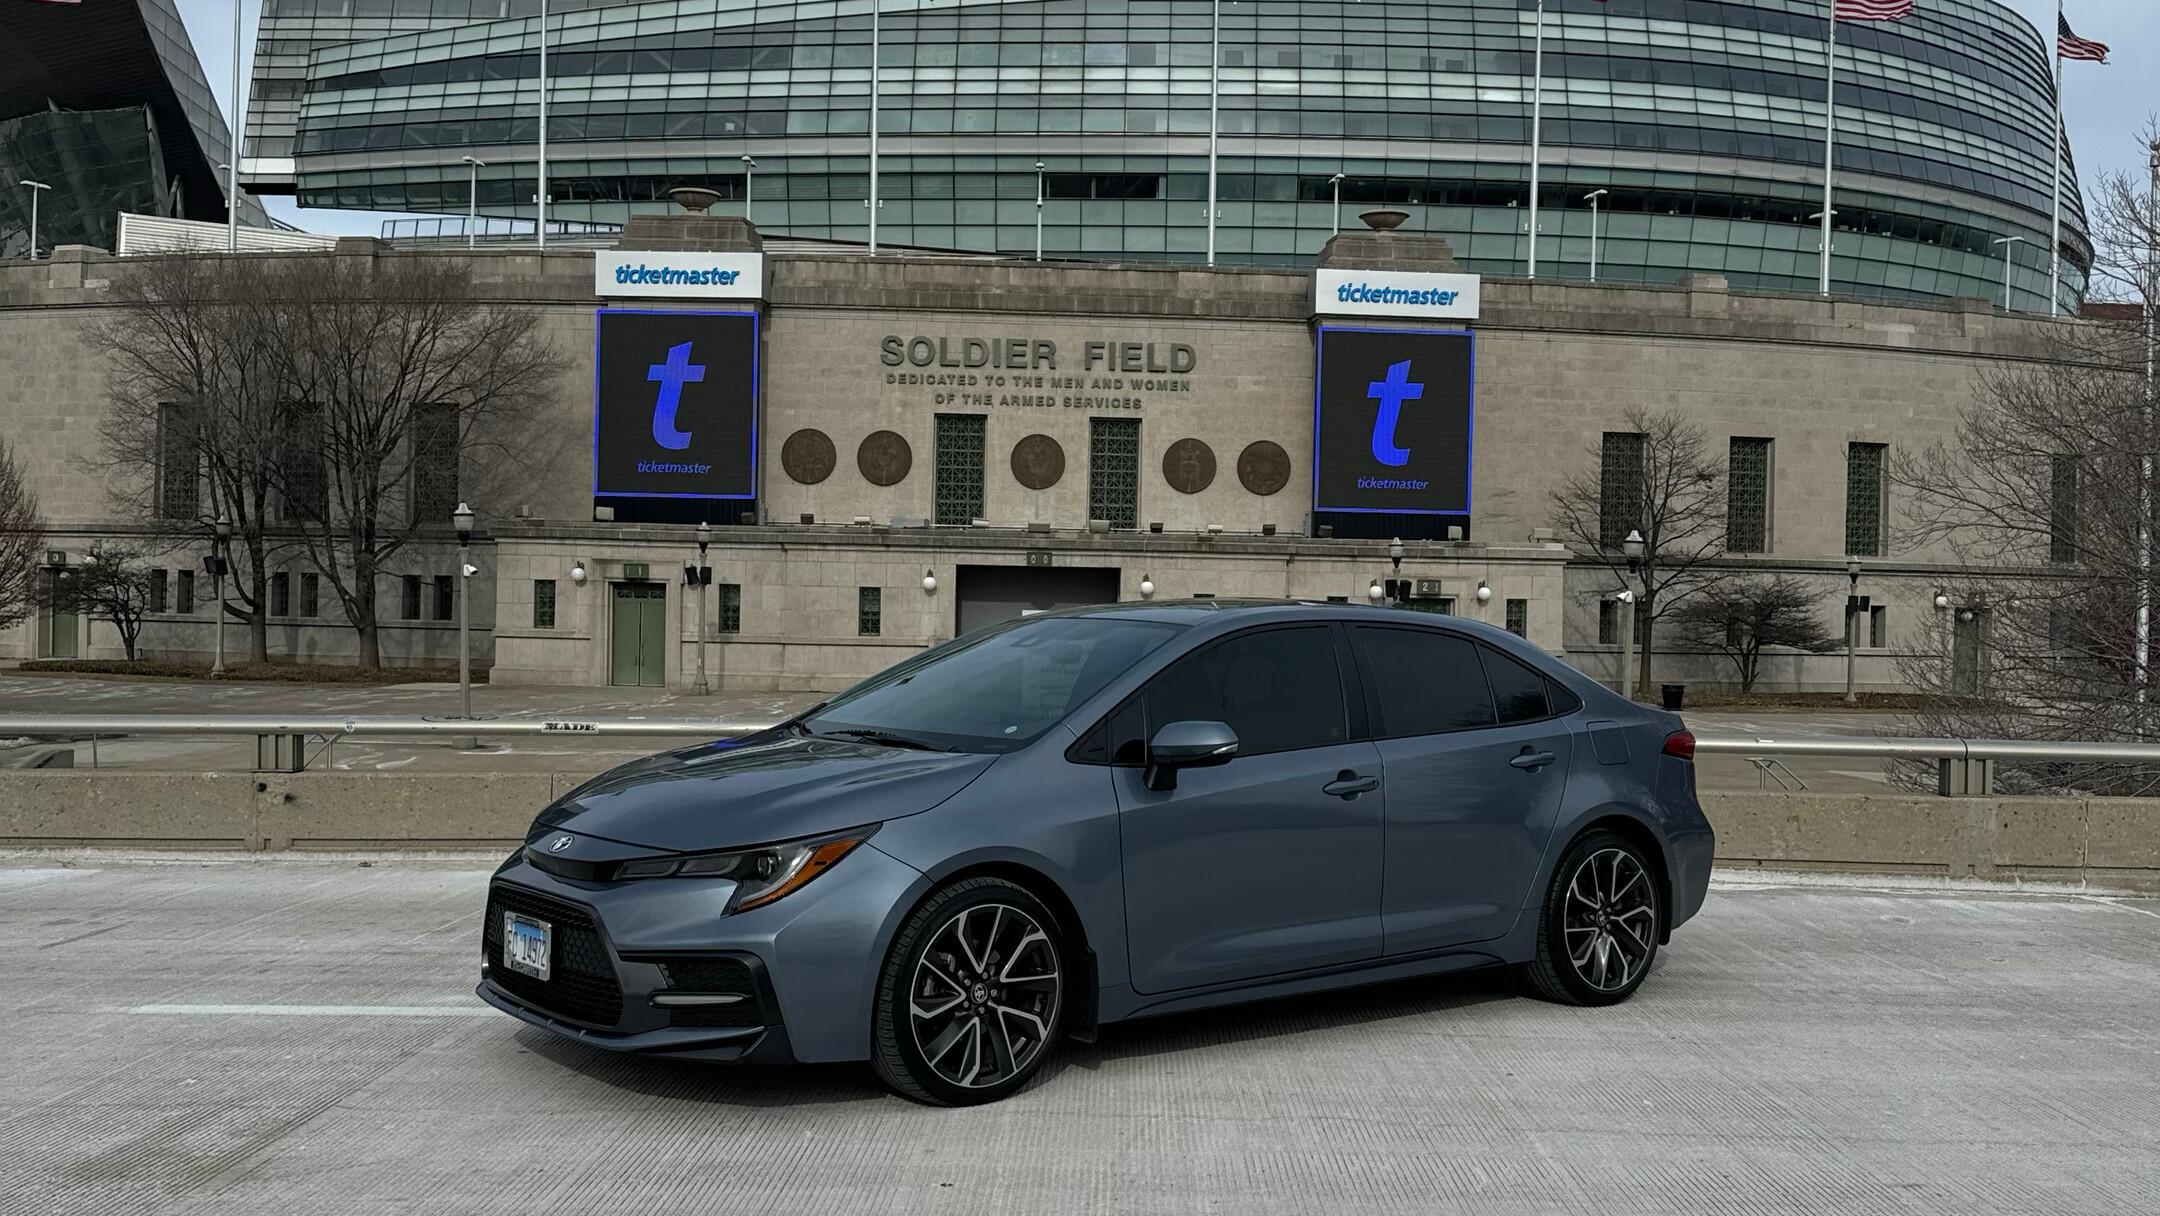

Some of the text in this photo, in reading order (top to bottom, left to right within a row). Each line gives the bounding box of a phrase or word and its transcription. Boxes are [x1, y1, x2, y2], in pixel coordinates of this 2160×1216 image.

[615, 264, 740, 286] ticketmaster
[1337, 283, 1458, 306] ticketmaster
[880, 335, 1197, 374] SOLDIER FIELD
[886, 373, 1190, 392] DEDICATED TO THE MEN AND WOMEN
[646, 341, 706, 450] t
[934, 393, 1142, 409] OF THE ARMED SERVICES
[1367, 360, 1425, 467] t
[637, 460, 712, 475] ticketmaster
[1356, 476, 1429, 490] ticketmaster
